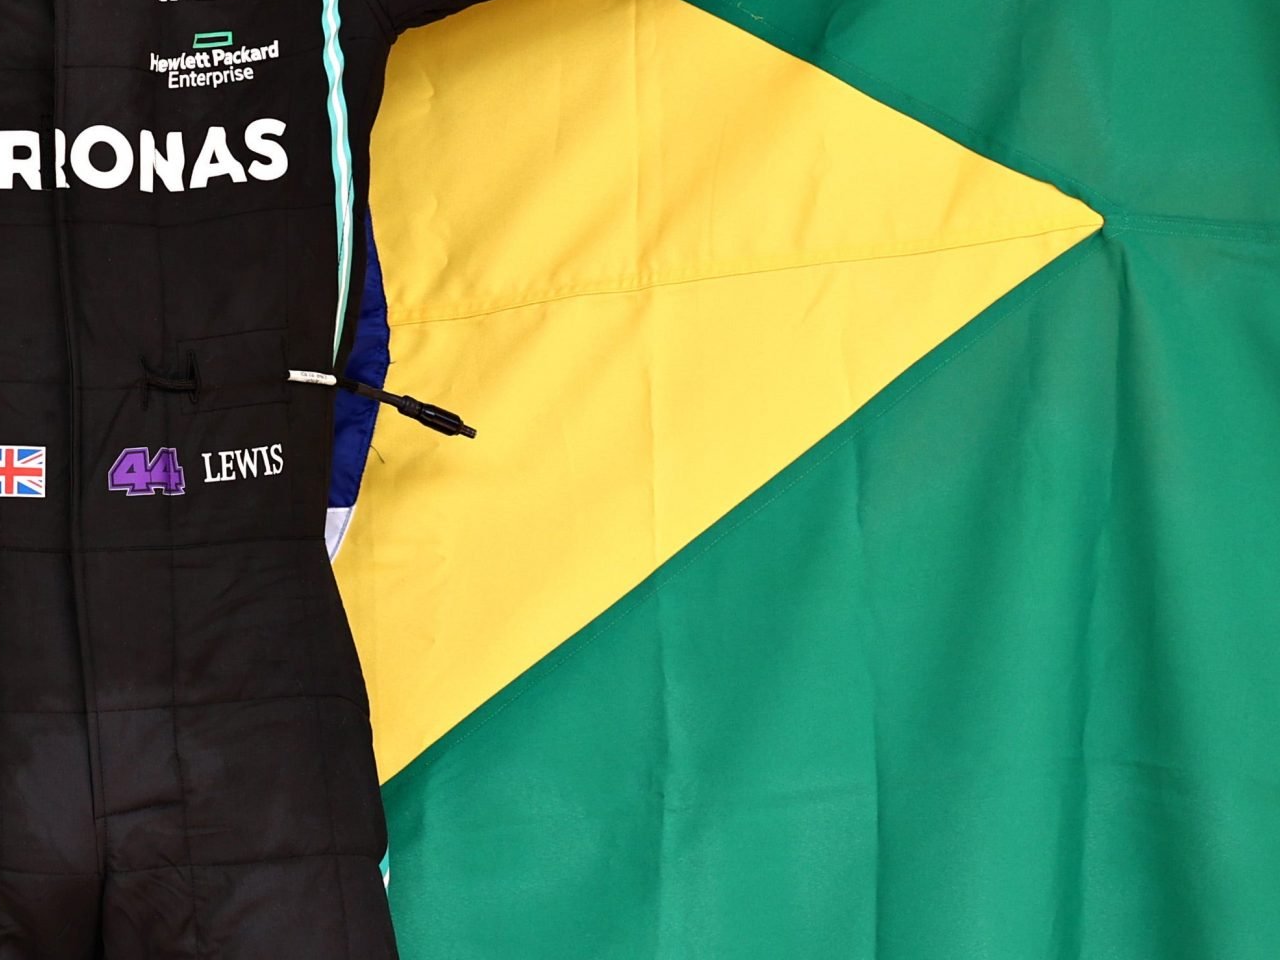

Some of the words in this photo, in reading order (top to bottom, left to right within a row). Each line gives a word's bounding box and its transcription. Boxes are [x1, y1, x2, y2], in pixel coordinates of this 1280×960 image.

[150, 51, 211, 73] Hewlett
[211, 40, 280, 67] Packard
[168, 66, 255, 89] Enterprise
[107, 446, 186, 497] 44
[200, 443, 285, 483] LEWIS
